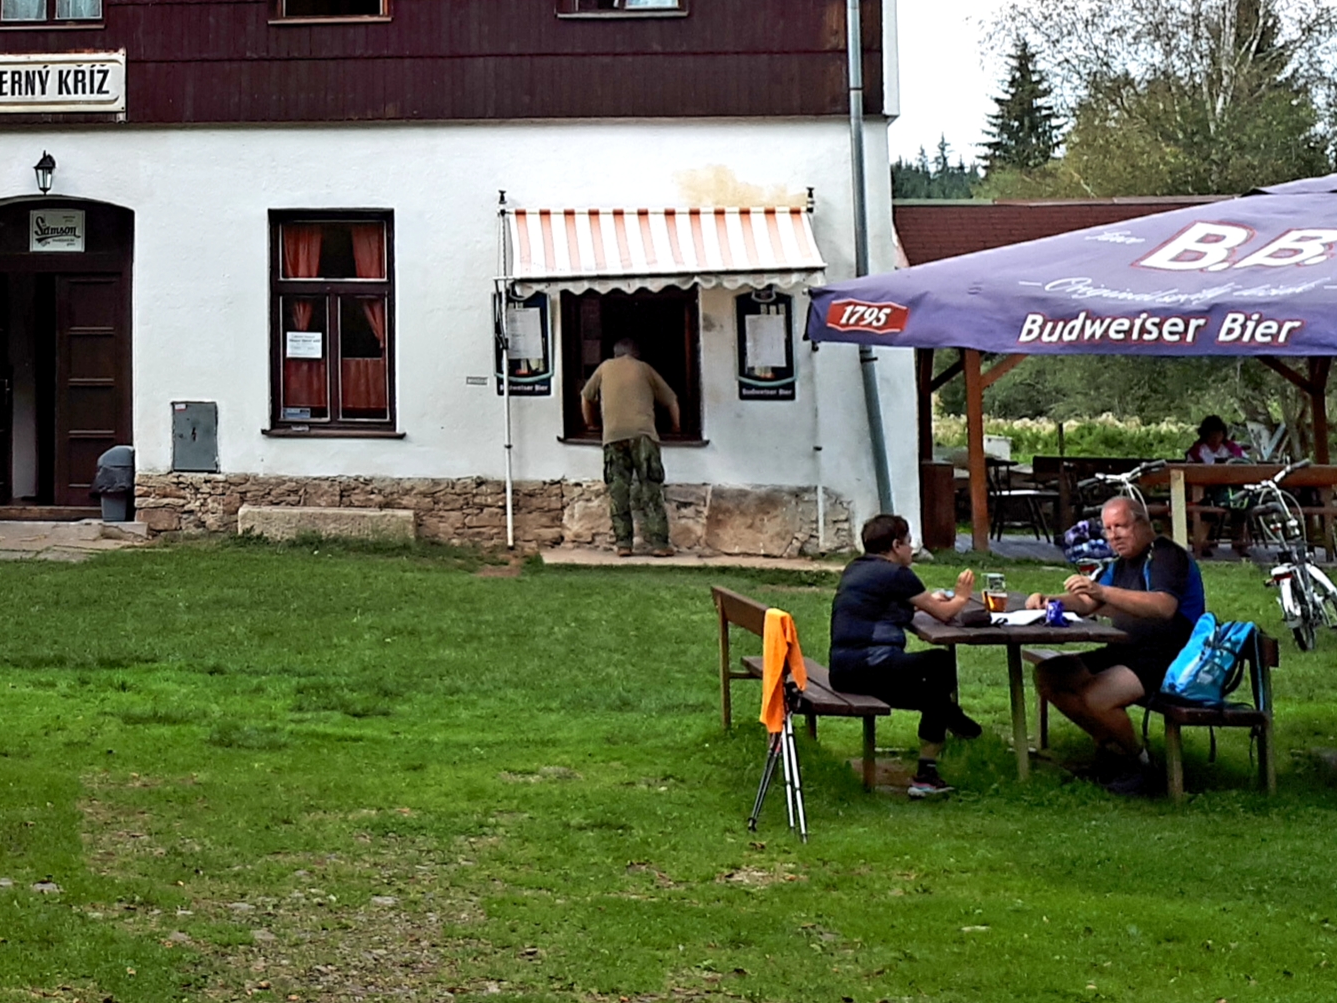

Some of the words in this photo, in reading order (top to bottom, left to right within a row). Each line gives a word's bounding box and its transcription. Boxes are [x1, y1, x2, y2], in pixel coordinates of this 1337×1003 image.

[57, 64, 110, 96] KŘÍŽ
[34, 215, 81, 238] Samson
[839, 305, 892, 327] 1795
[1018, 310, 1207, 344] Budweiser
[1216, 311, 1302, 344] Bier
